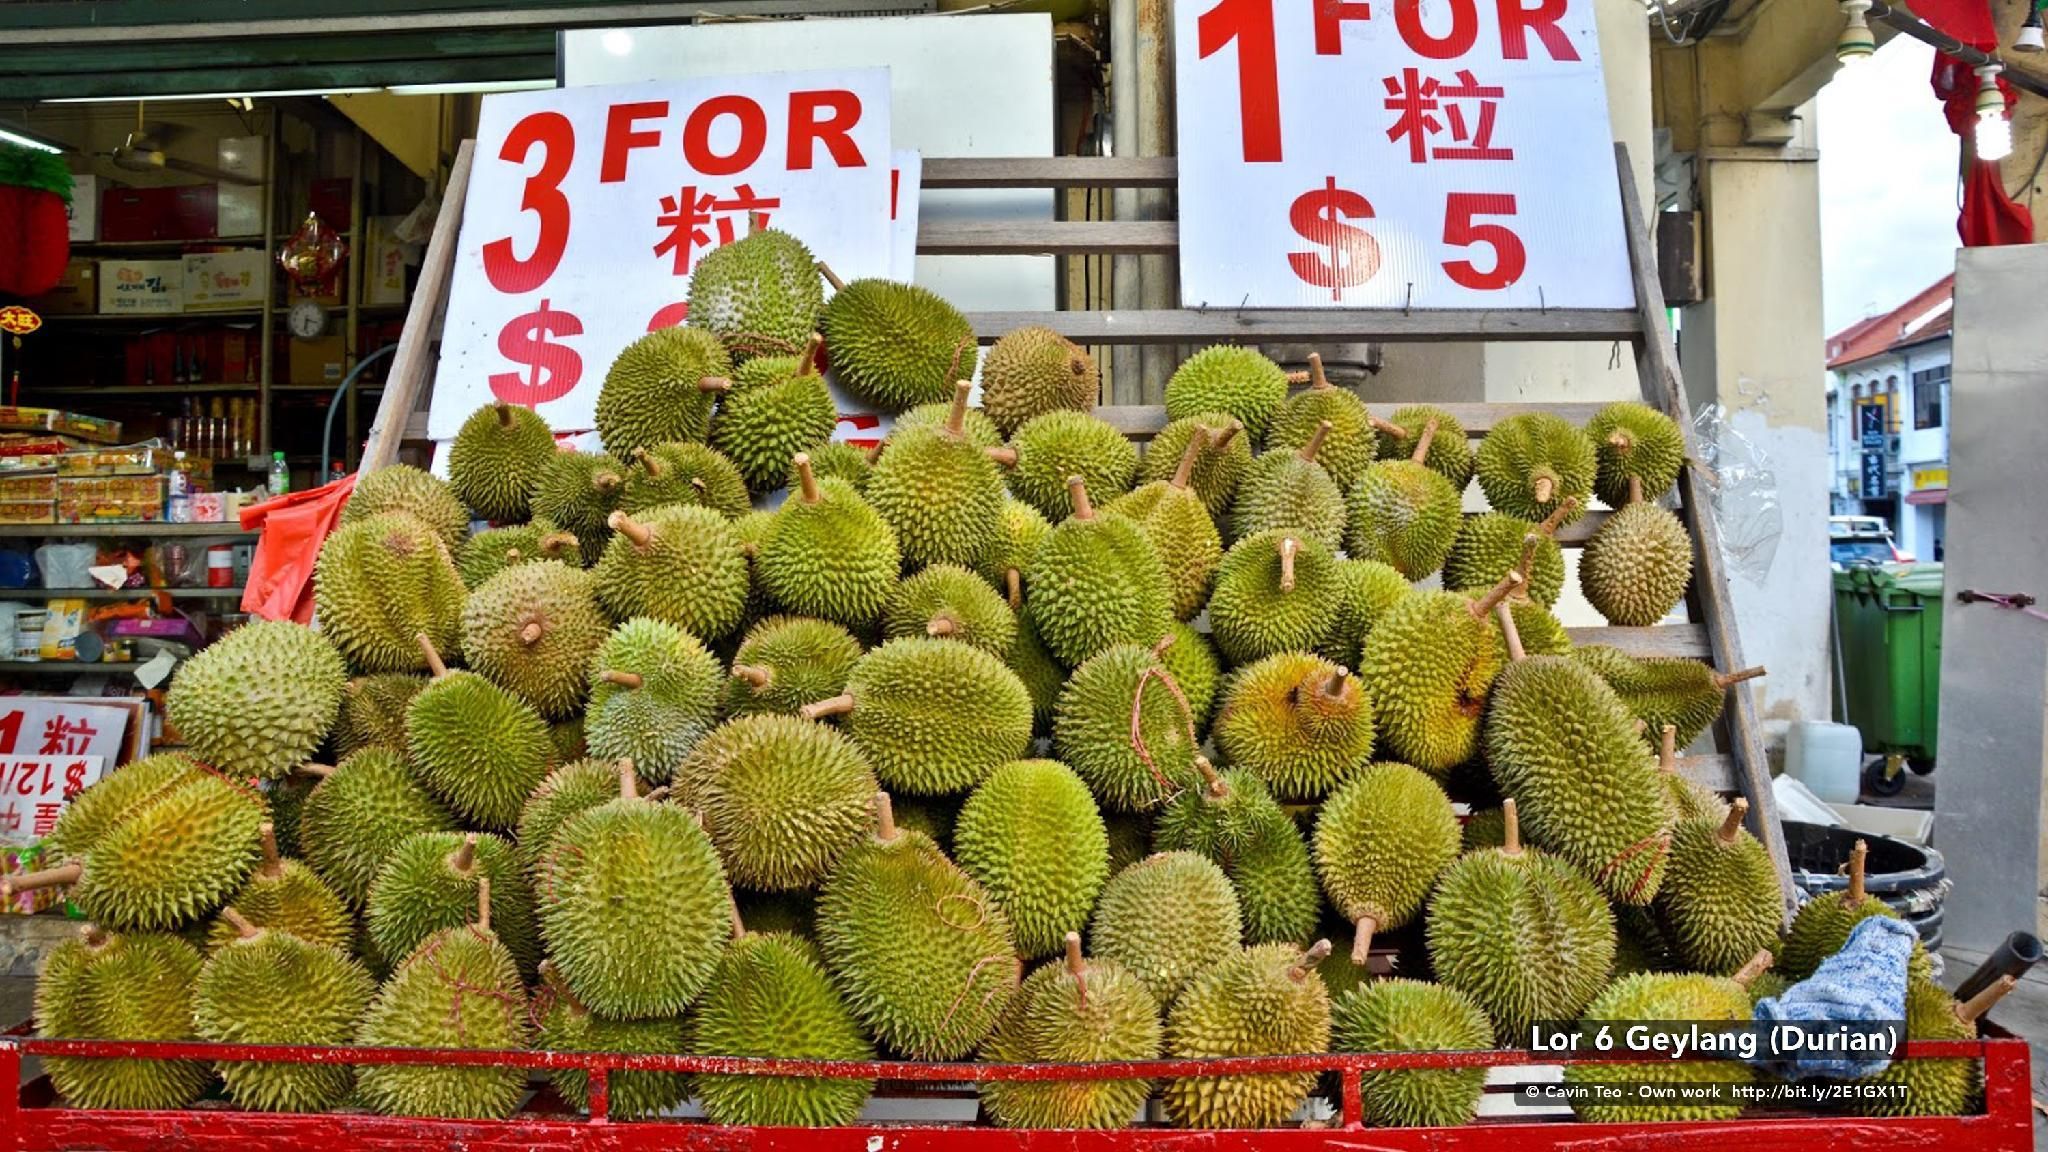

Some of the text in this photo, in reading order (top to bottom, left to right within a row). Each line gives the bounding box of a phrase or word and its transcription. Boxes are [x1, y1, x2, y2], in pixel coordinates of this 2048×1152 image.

[1197, 0, 1580, 163] 1 FOR
[1382, 67, 1514, 163] 粒
[482, 89, 867, 295] 3 FOR
[654, 183, 781, 276] 粒
[1287, 176, 1527, 302] $ 5
[488, 299, 584, 410] $
